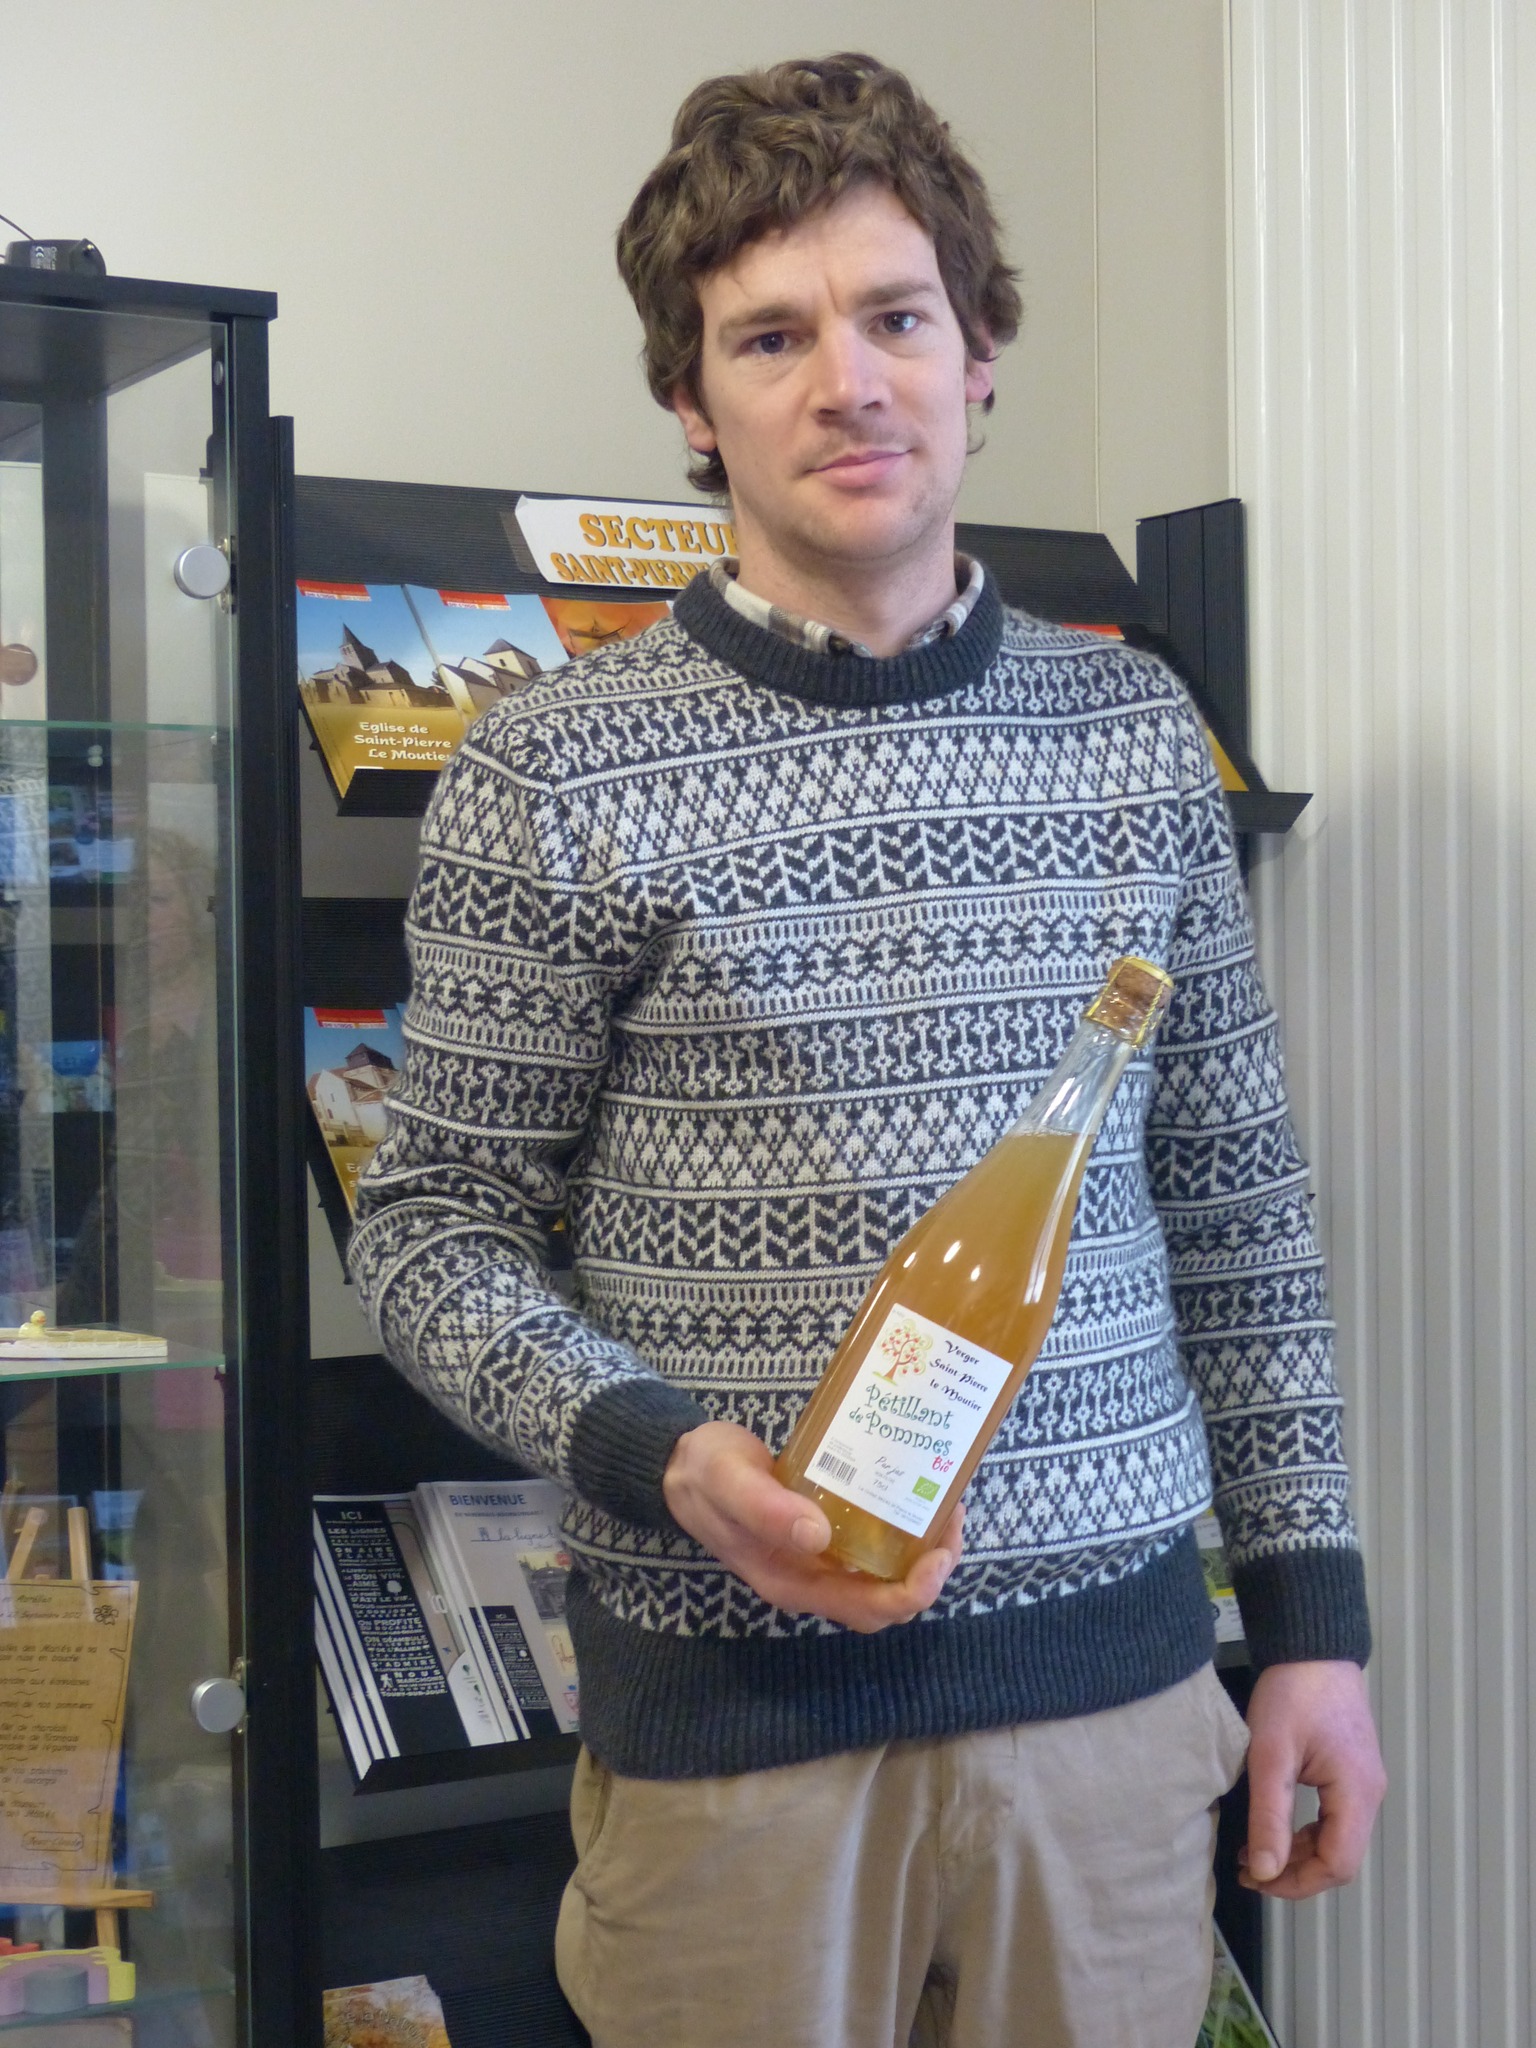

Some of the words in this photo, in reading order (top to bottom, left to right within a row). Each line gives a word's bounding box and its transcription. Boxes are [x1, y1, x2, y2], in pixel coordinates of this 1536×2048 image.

[359, 721, 406, 734] Eglise
[409, 724, 429, 734] de
[353, 734, 452, 748] Saint-Pierre
[368, 748, 388, 759] Le
[945, 1340, 980, 1365] Verger
[929, 1378, 940, 1389] le
[941, 1385, 982, 1411] Moutier
[864, 1383, 954, 1430] Pétillant
[848, 1406, 864, 1423] de
[864, 1410, 953, 1457] Pommes
[931, 1455, 954, 1473] Bio
[448, 1494, 528, 1506] BIENVENUE
[340, 1511, 363, 1520] ICI
[373, 1617, 422, 1626] PROFITE
